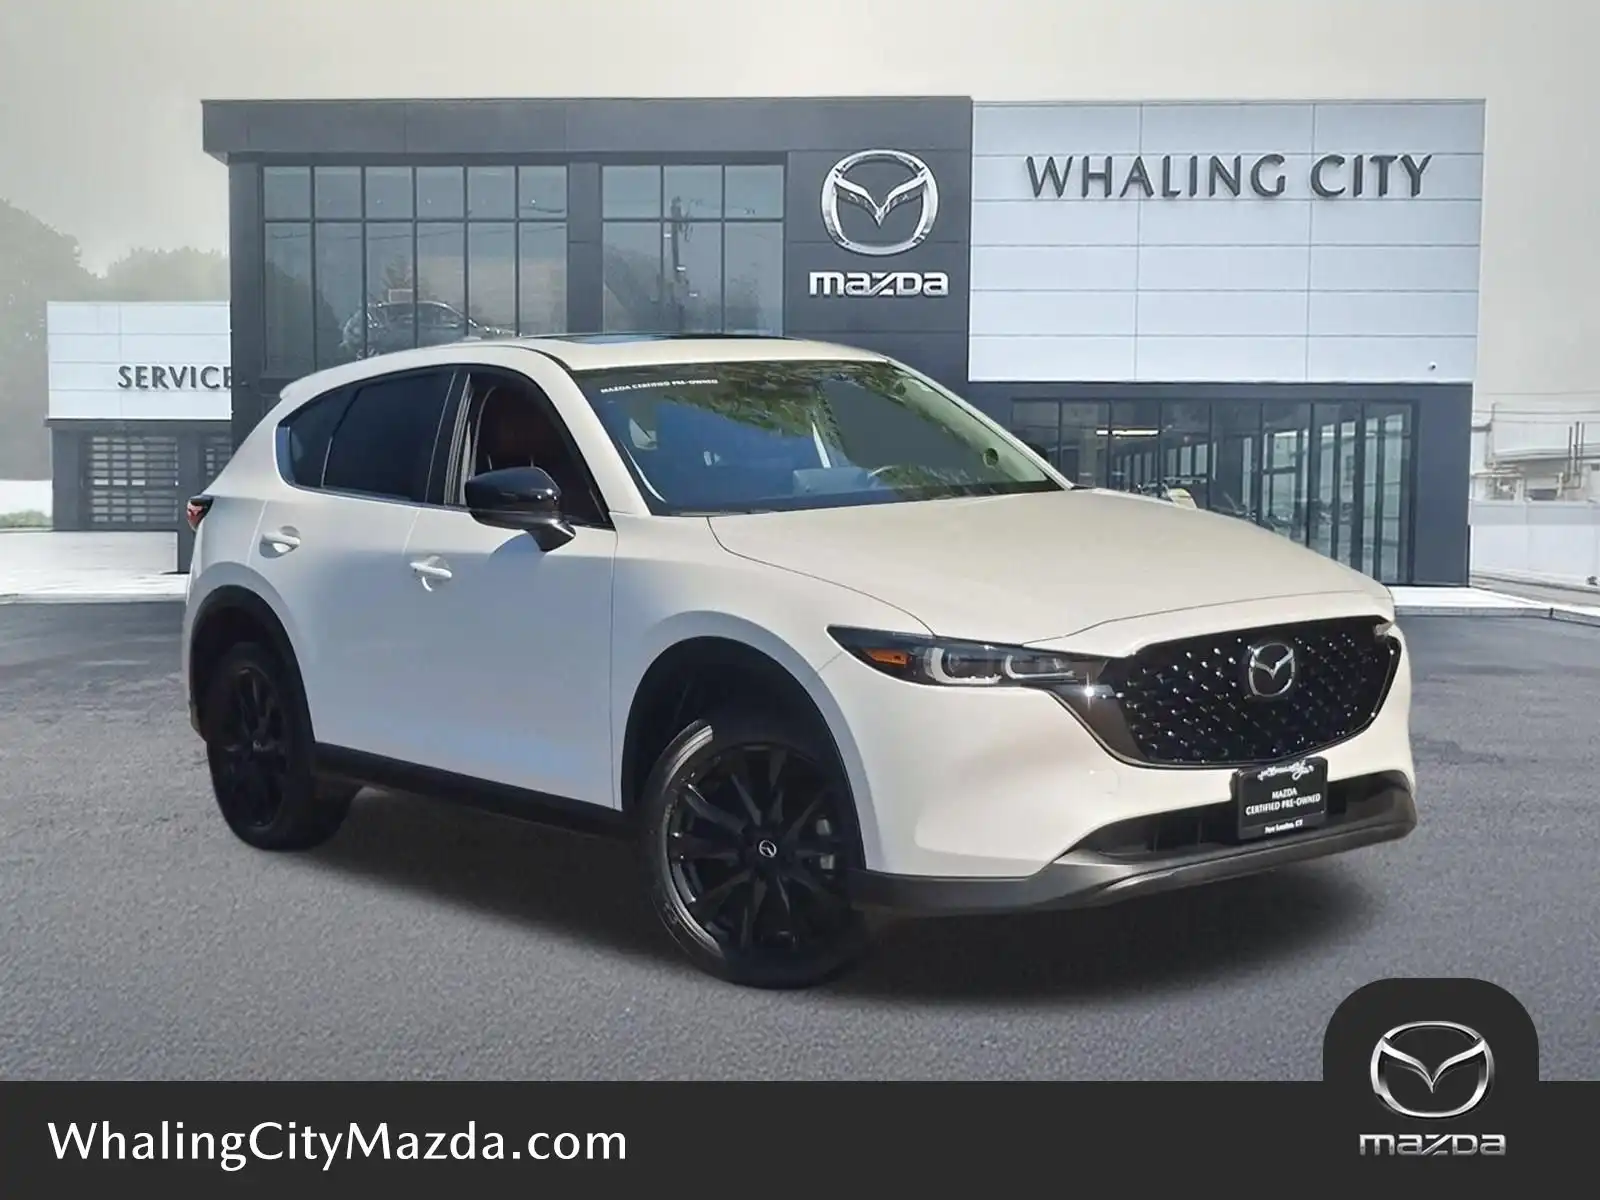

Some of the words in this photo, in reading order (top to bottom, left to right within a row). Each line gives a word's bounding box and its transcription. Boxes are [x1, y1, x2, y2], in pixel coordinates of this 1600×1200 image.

[1025, 154, 1286, 198] WHALING
[1309, 154, 1432, 198] CITY
[1245, 802, 1280, 815] CERTIFIED
[1282, 793, 1321, 808] PRE-OWNED
[1272, 787, 1298, 799] MAZDA
